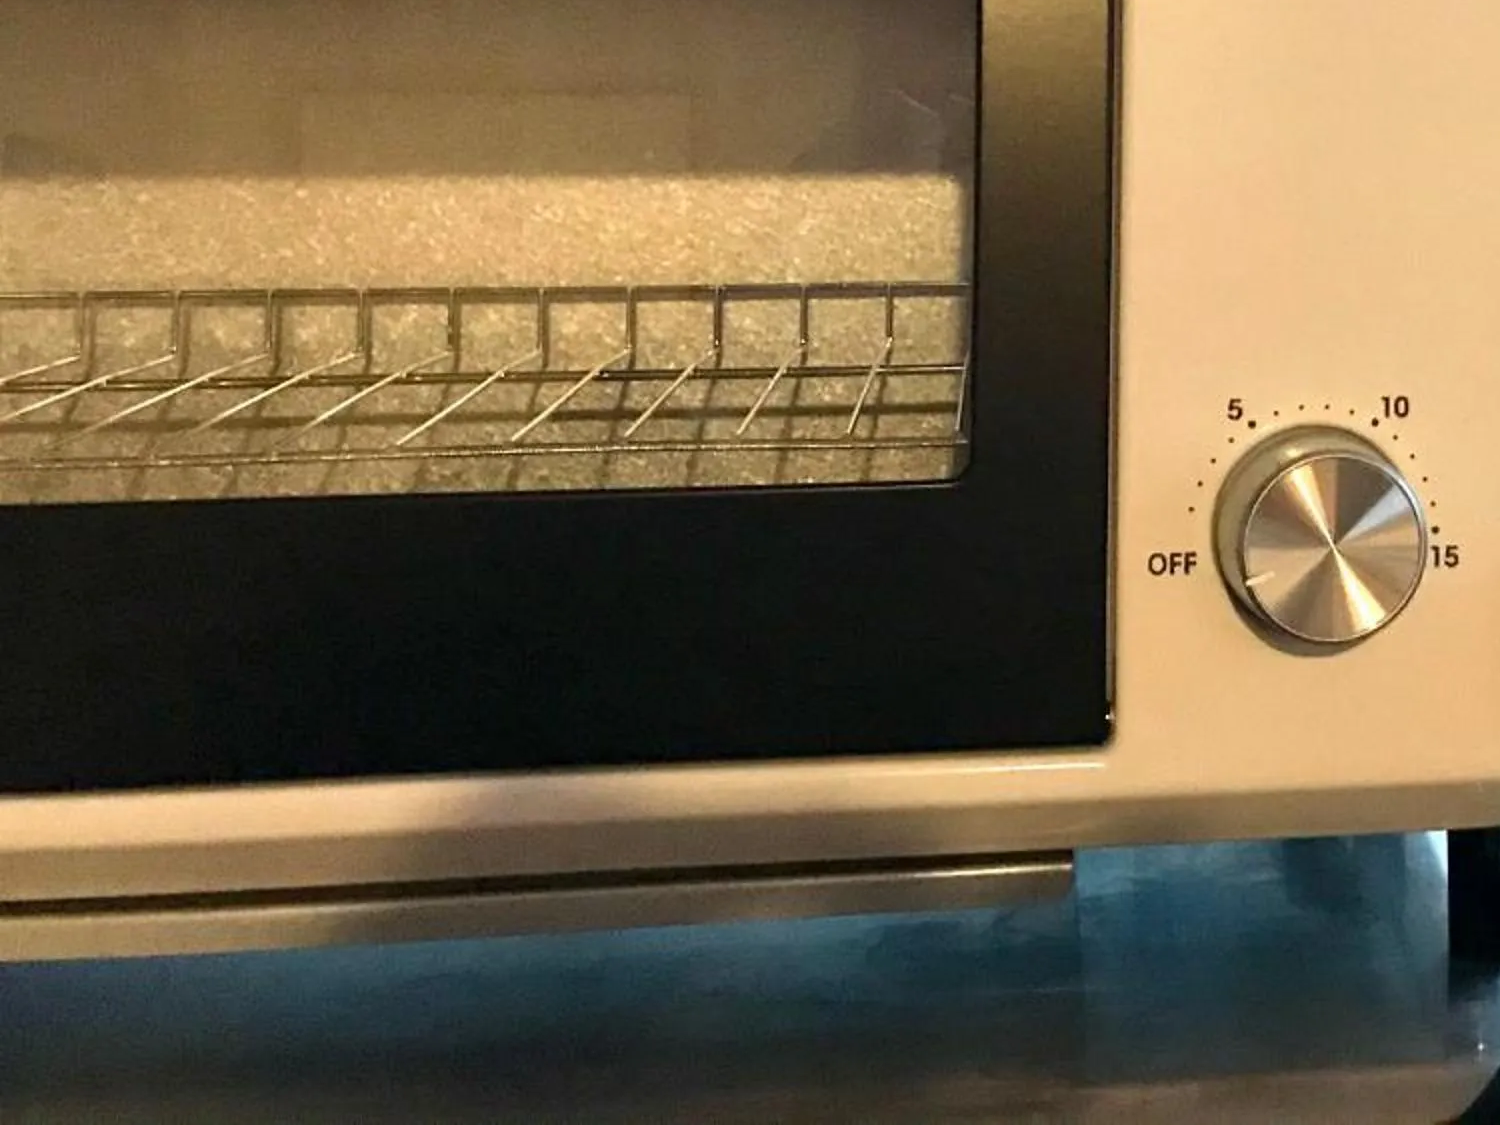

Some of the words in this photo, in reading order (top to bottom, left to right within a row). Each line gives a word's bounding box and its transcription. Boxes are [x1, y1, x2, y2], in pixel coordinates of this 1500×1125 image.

[1227, 399, 1243, 420] 5
[1381, 396, 1410, 418] 10
[1147, 551, 1198, 575] OFF
[1431, 545, 1460, 568] 15
